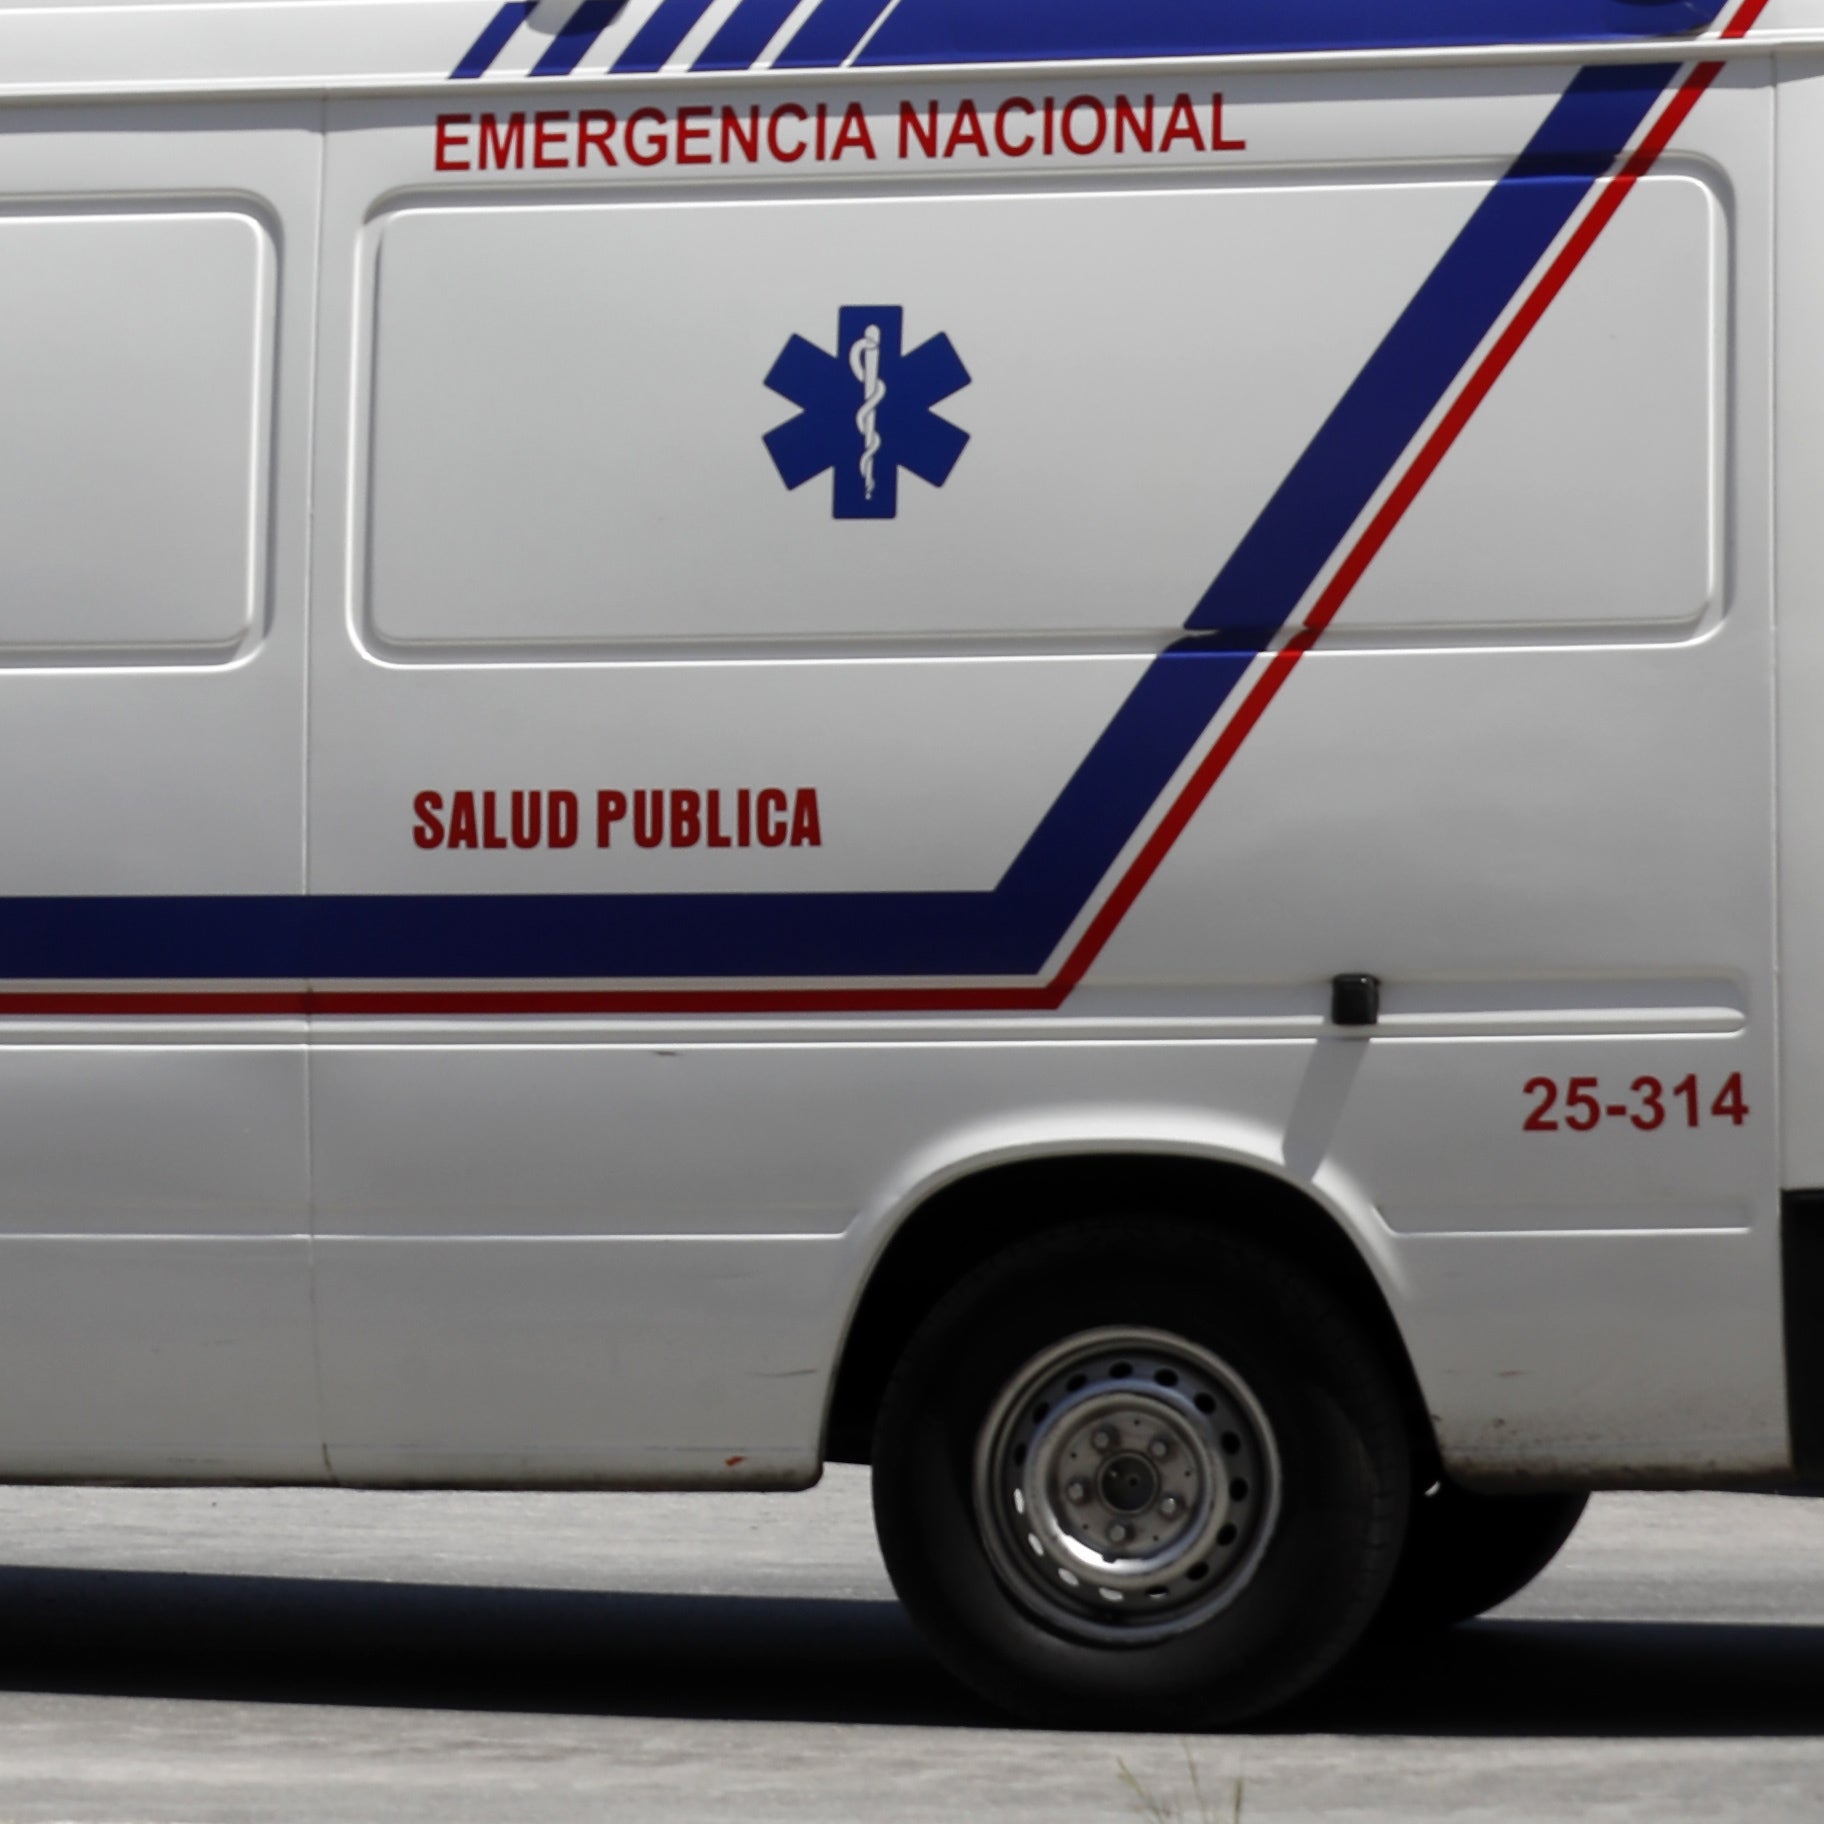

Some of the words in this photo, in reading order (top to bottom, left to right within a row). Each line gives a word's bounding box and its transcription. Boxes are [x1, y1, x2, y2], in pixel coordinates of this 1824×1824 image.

[433, 101, 877, 172] EMERGENCIA
[898, 92, 1247, 159] NACIONAL
[412, 789, 579, 849] SALUD
[596, 788, 822, 848] PUBLICA
[1522, 1072, 1750, 1132] 25-314
